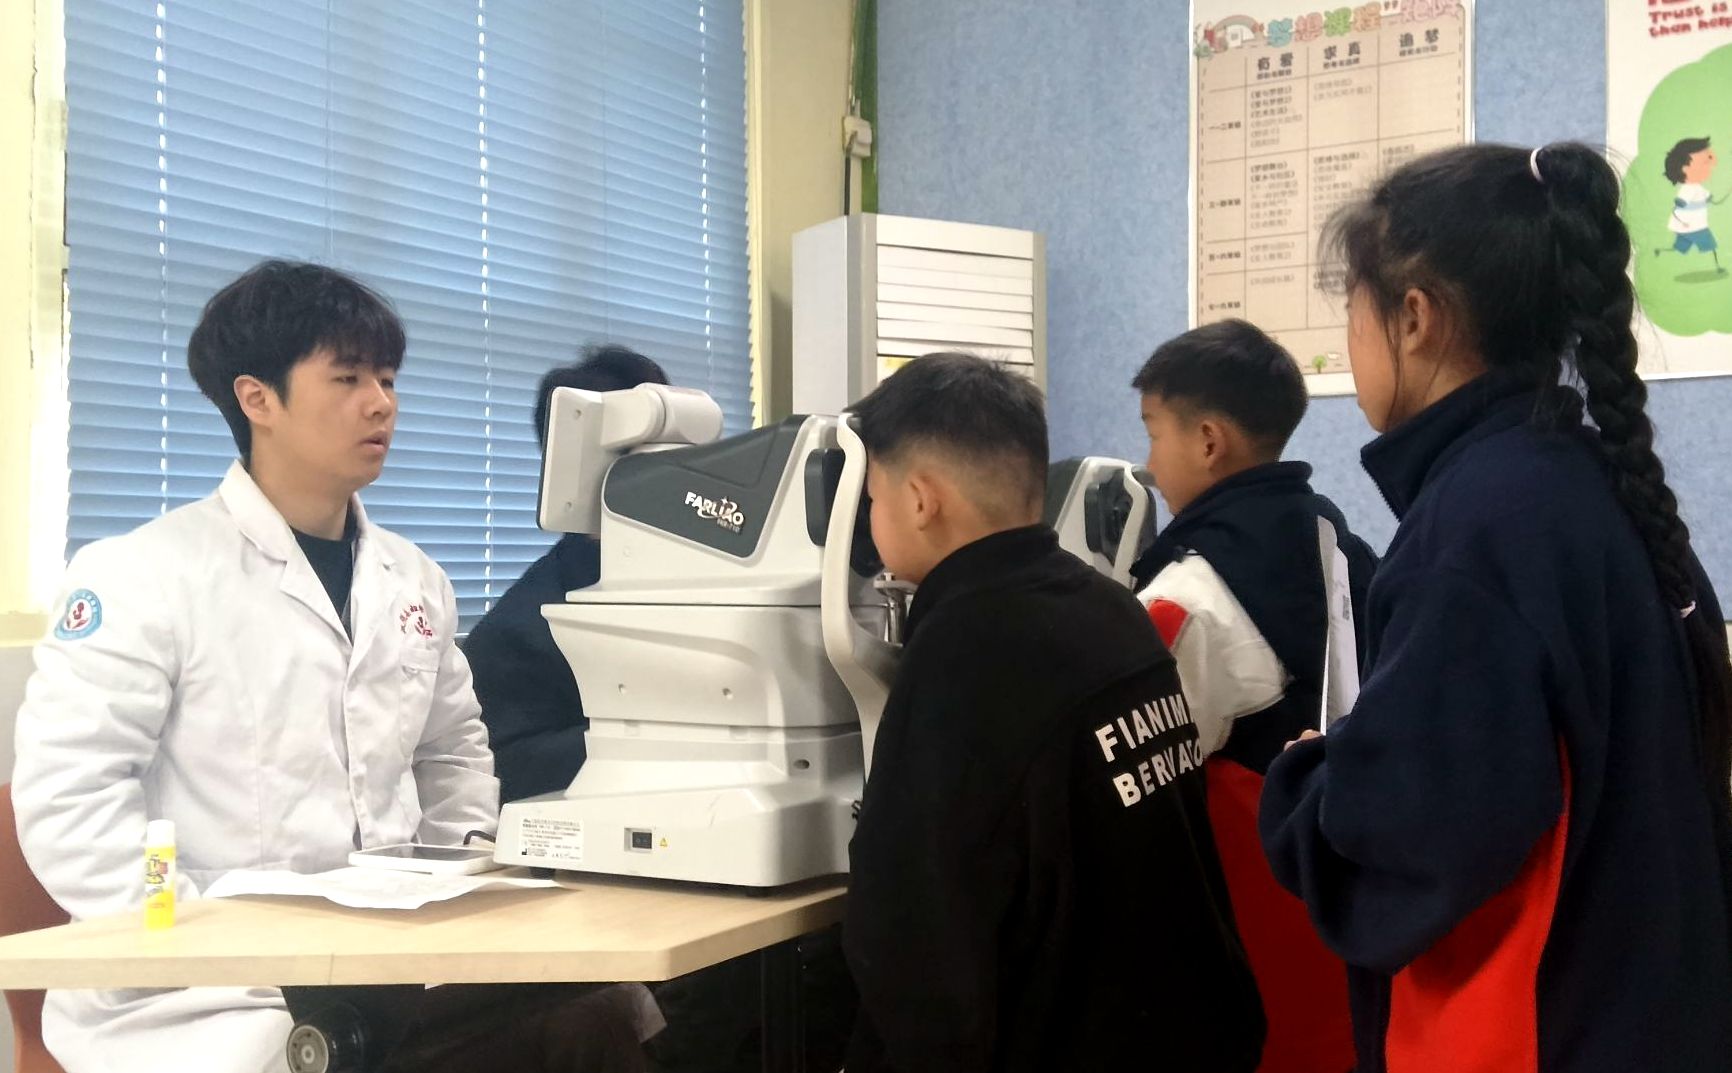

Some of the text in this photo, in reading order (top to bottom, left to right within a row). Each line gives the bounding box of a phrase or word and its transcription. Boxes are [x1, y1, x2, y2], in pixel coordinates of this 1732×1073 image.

[1648, 2, 1728, 24] Trust is
[1649, 23, 1692, 38] than
[1095, 693, 1194, 762] FIANIM
